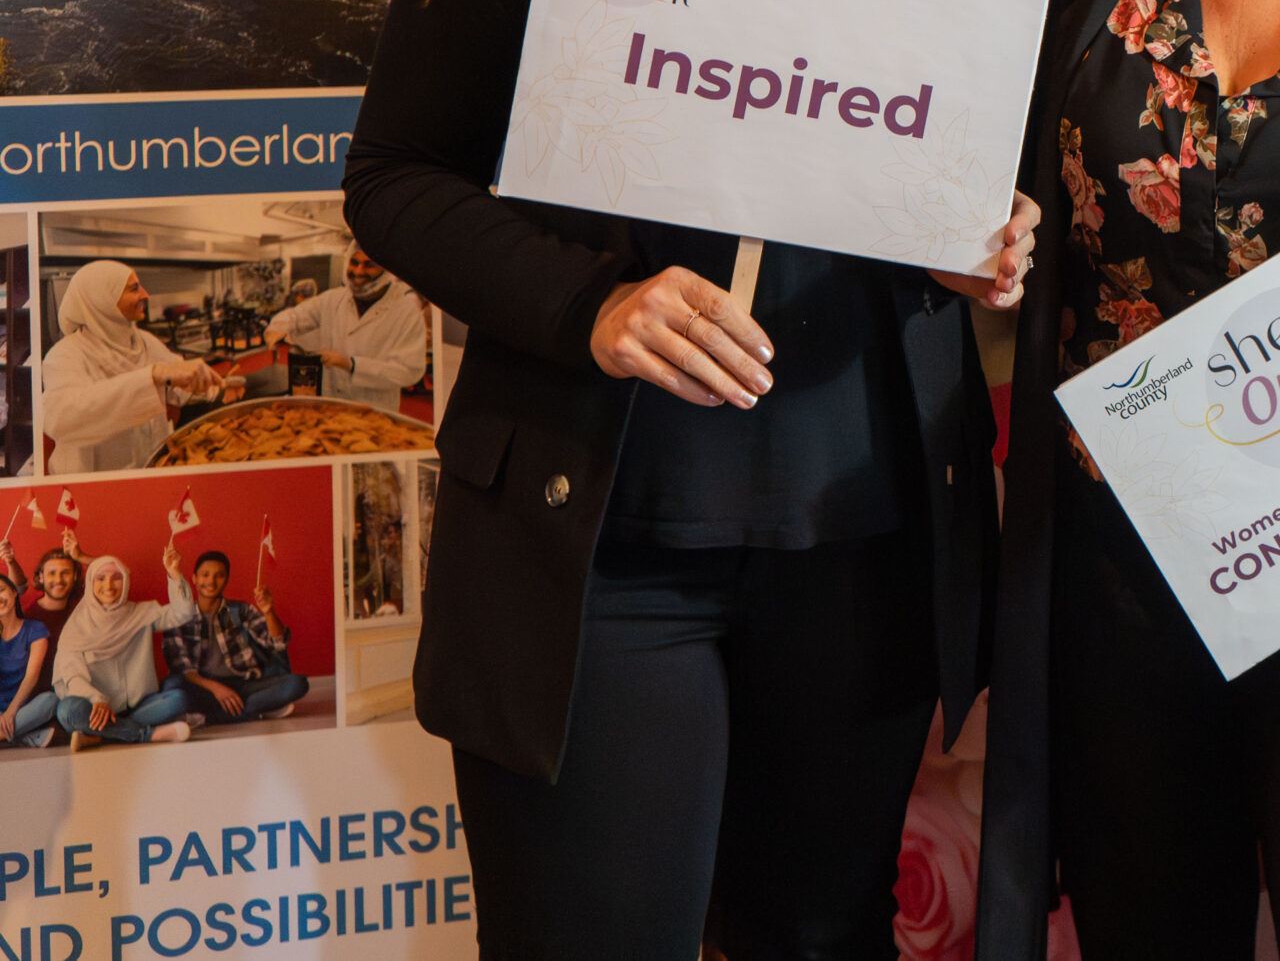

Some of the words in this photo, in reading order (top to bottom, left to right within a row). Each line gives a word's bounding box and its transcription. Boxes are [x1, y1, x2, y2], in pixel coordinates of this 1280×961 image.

[624, 32, 934, 140] Inspired
[1105, 357, 1193, 416] Northumberland
[1120, 385, 1168, 419] county
